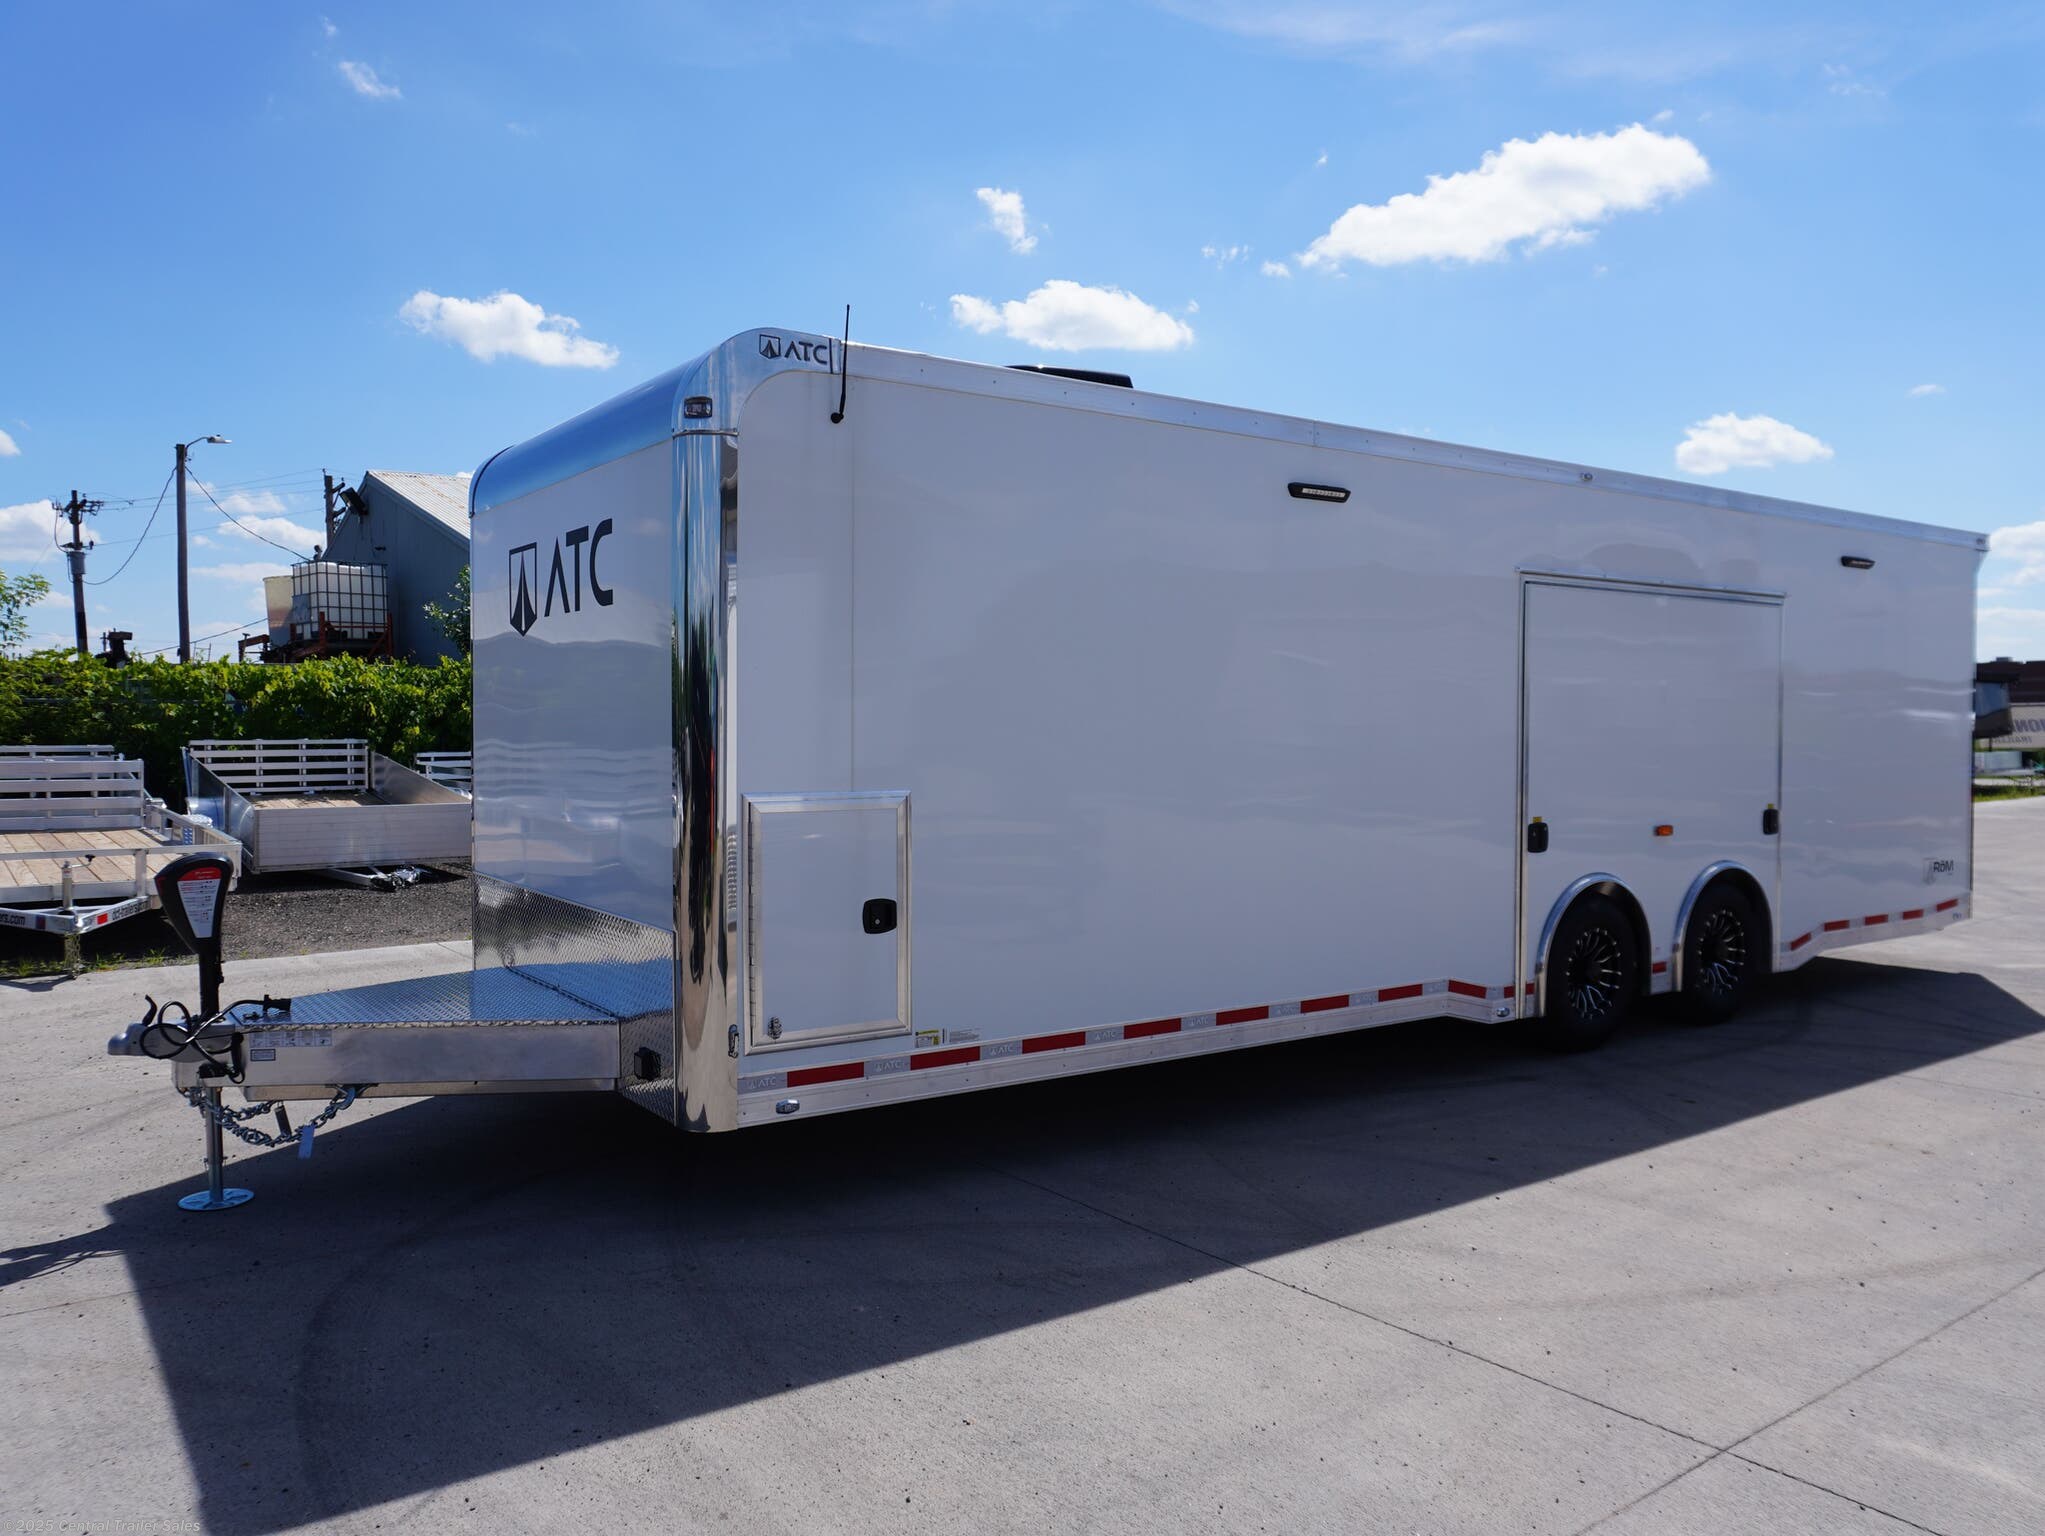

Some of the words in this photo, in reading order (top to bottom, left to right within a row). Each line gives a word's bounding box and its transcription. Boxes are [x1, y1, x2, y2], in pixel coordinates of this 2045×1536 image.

[784, 340, 828, 365] ATC
[544, 518, 614, 618] ATC
[885, 1060, 902, 1072] ATC
[758, 1076, 777, 1087] ATC
